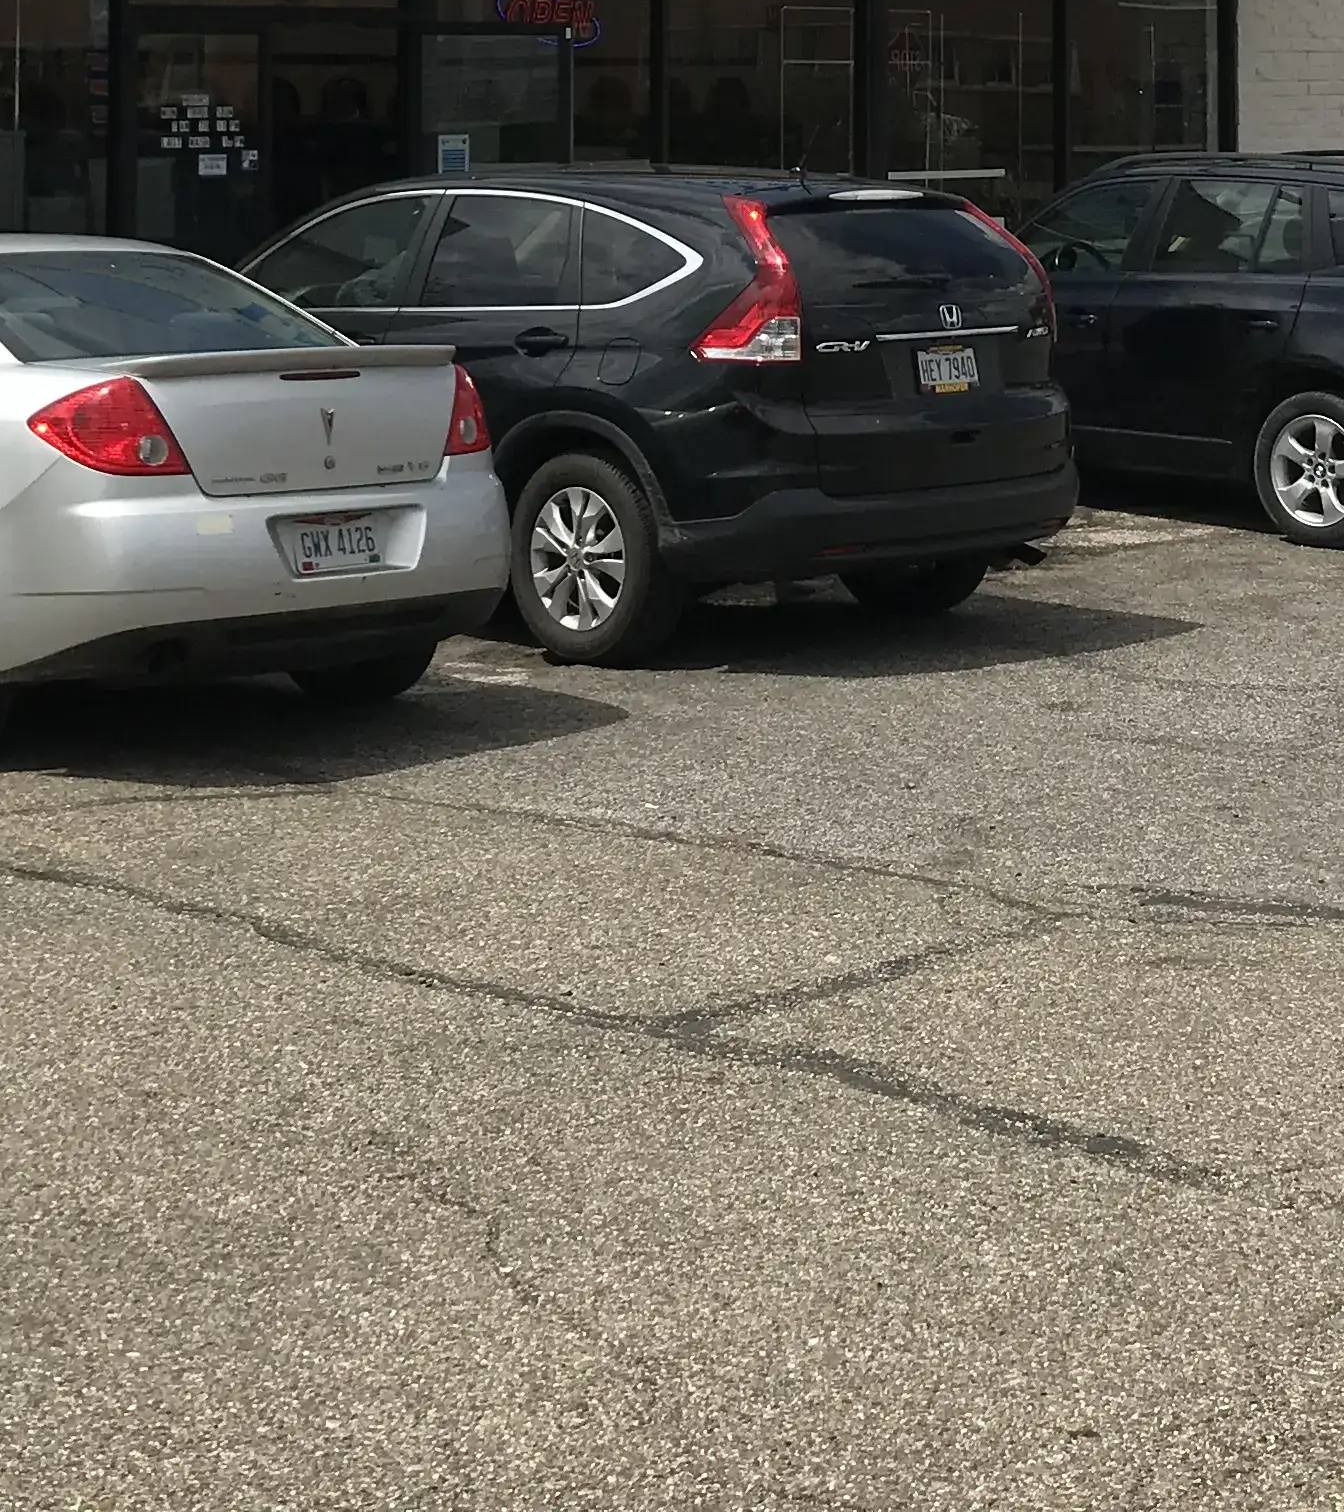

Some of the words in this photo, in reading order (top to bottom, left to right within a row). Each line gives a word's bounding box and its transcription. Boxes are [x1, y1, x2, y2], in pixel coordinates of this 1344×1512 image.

[815, 340, 871, 353] CR-V
[920, 358, 943, 382] HEY
[944, 355, 976, 380] 7940
[300, 530, 333, 558] GWX
[337, 526, 376, 555] 4126
